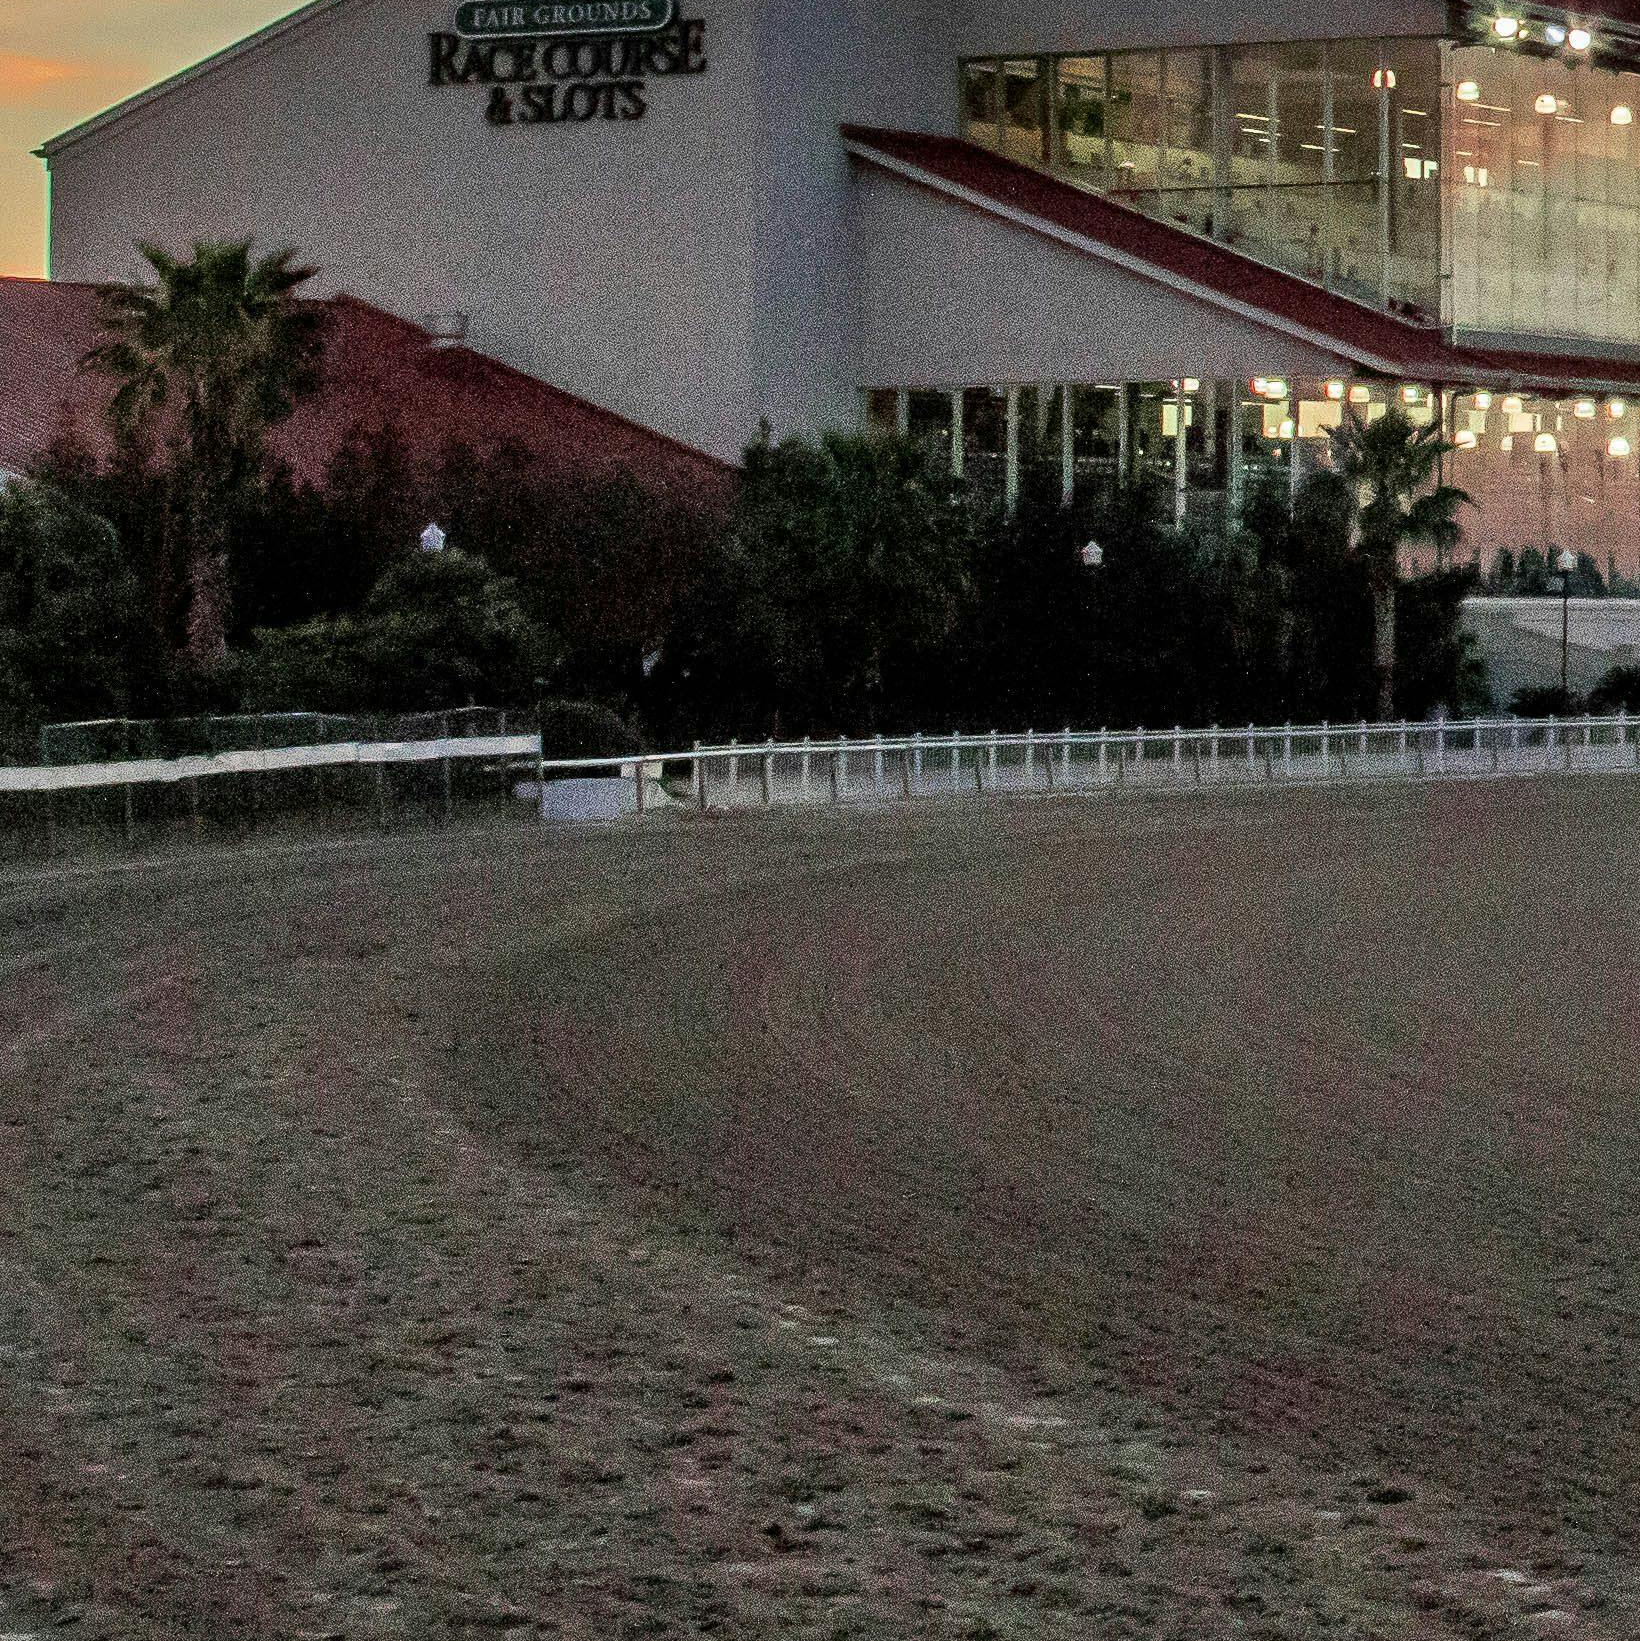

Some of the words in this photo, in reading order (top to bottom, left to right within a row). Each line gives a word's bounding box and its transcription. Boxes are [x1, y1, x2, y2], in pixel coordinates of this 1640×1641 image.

[471, 6, 526, 28] FAIR
[532, 0, 653, 26] GROUNDS
[428, 32, 537, 86] RACE
[542, 18, 708, 78] COURSE
[486, 86, 514, 126] &
[518, 80, 648, 124] SLOTS
